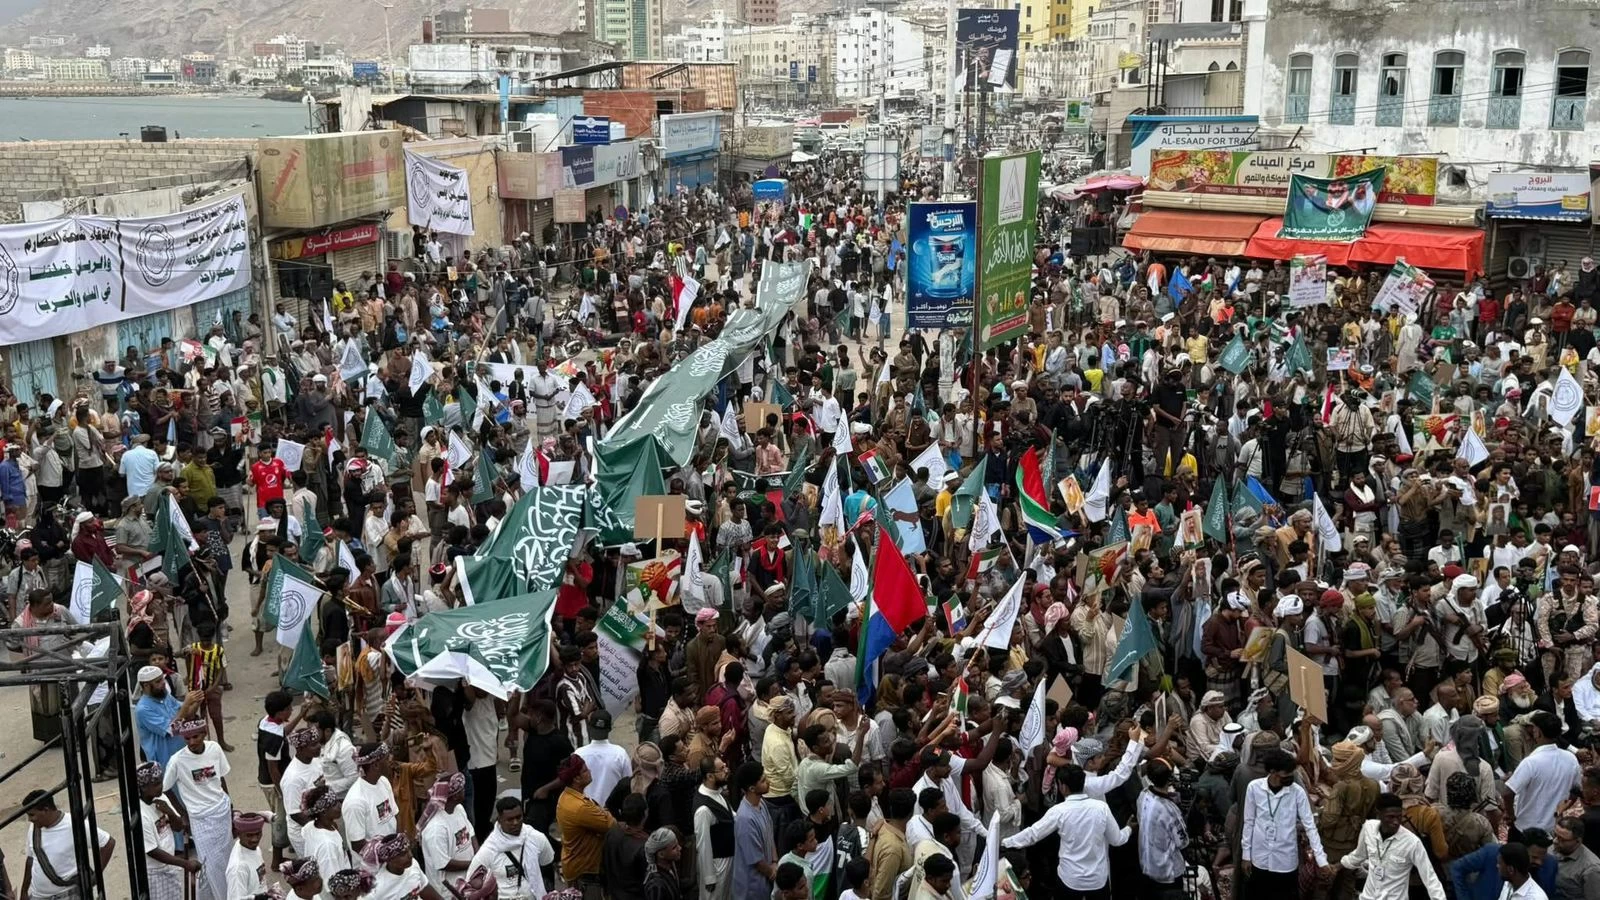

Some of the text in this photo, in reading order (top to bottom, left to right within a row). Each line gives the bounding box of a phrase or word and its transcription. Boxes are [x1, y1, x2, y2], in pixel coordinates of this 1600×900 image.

[1161, 125, 1211, 136] للتجارة
[1161, 137, 1205, 145] AL-ESAAD
[1207, 137, 1226, 145] FOR
[1249, 155, 1315, 171] مركز الميناء
[1528, 175, 1552, 185] البروج
[930, 213, 964, 229] النرجس
[101, 281, 111, 305] في
